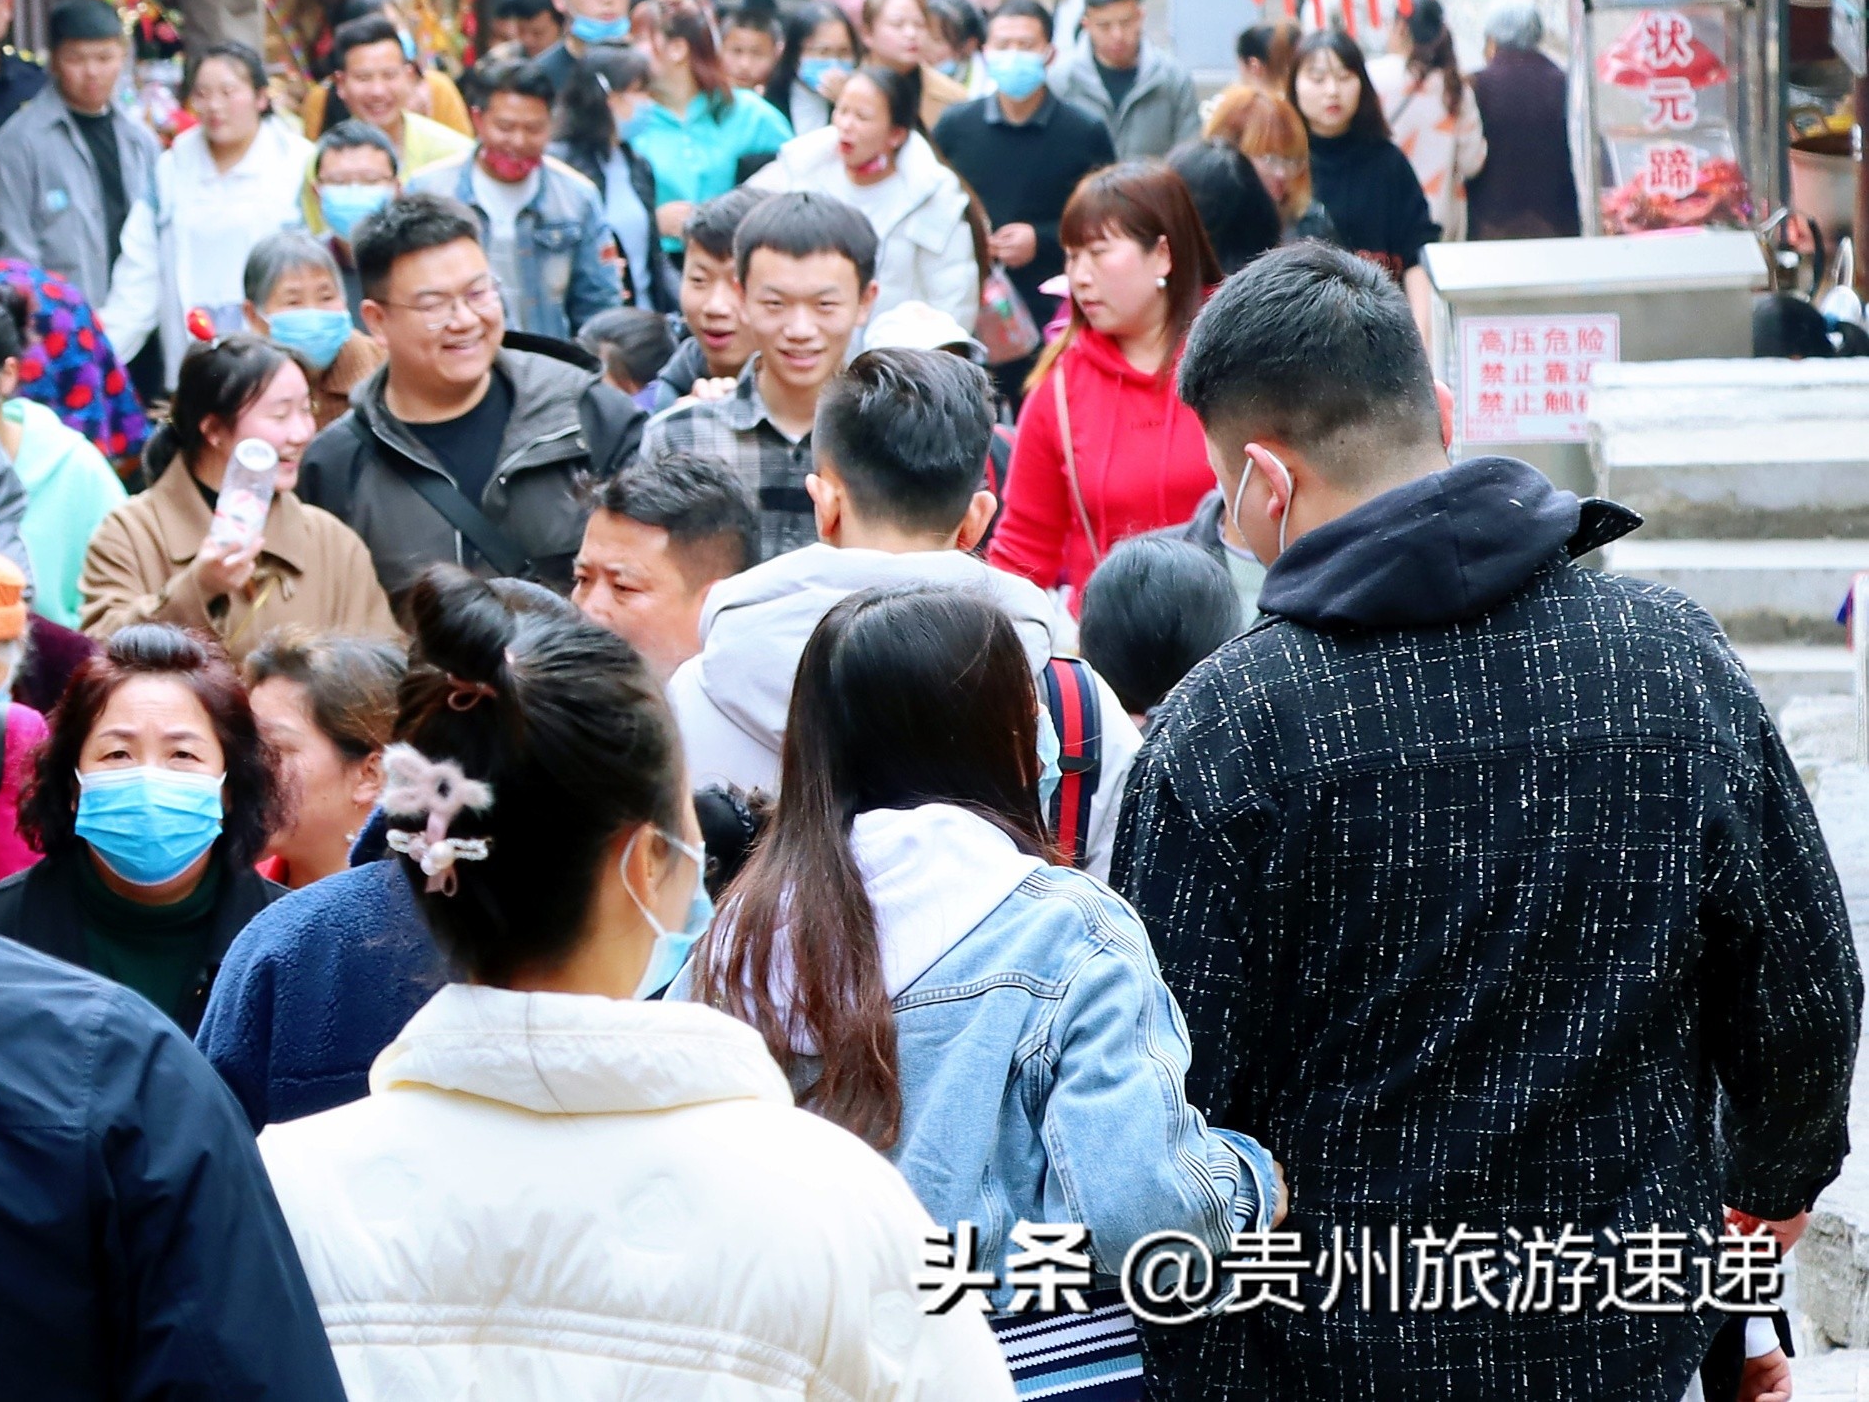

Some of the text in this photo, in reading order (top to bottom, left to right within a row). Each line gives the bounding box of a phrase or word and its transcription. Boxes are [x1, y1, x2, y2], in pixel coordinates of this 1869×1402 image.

[1645, 16, 1693, 192] 状元蹄
[1480, 326, 1605, 355] 高压危险
